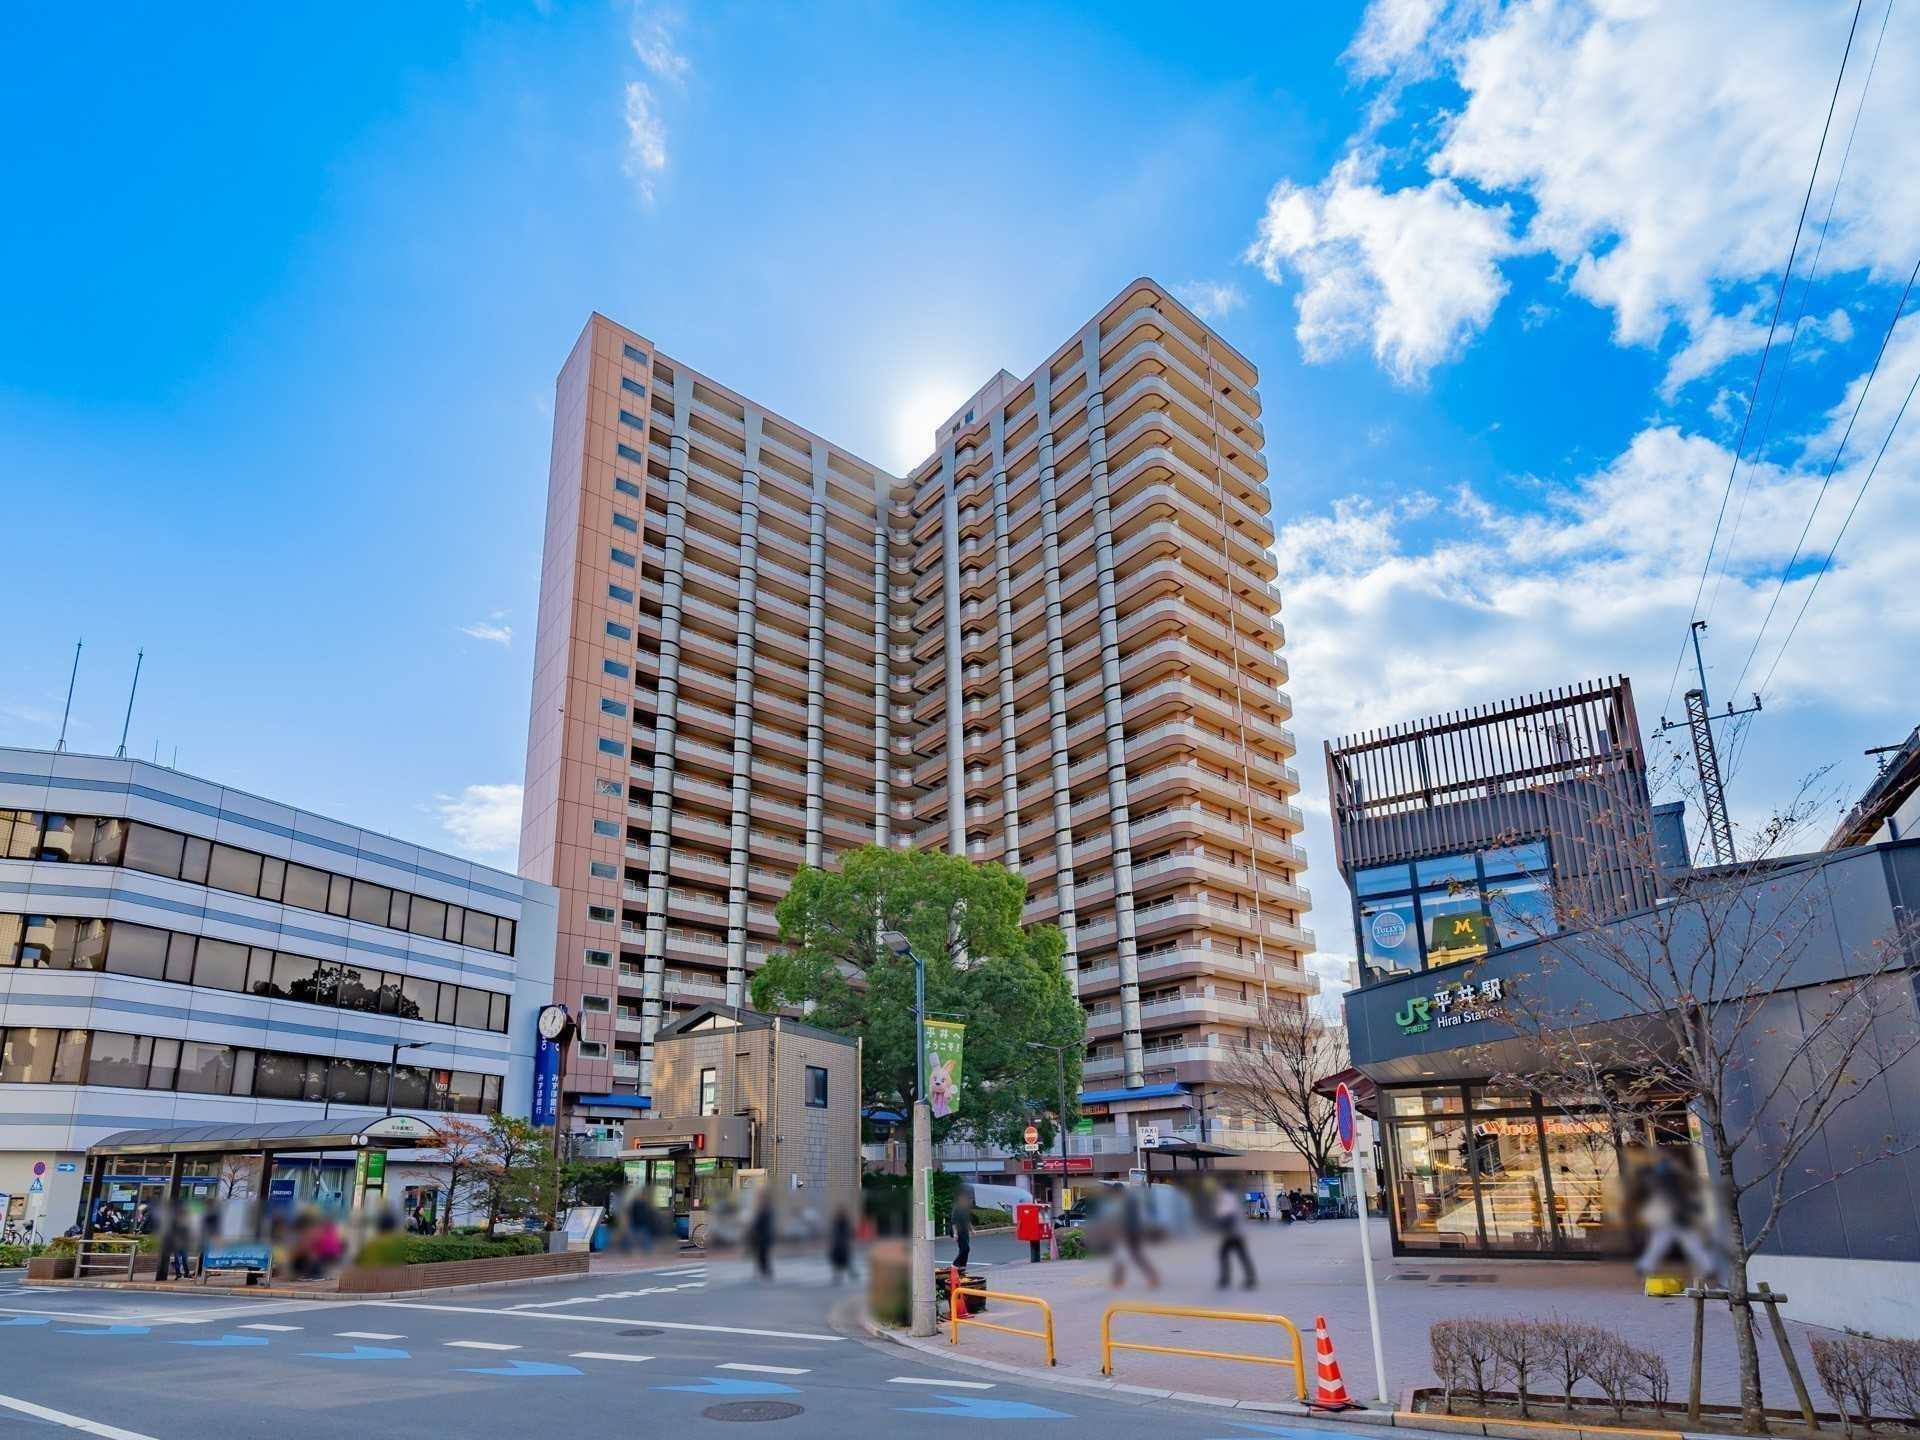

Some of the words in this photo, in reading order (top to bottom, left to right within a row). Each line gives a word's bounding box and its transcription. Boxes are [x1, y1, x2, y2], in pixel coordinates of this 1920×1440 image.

[1434, 978, 1502, 1012] 平井駅
[1396, 996, 1432, 1026] JR
[1437, 1014, 1461, 1028] Hirai
